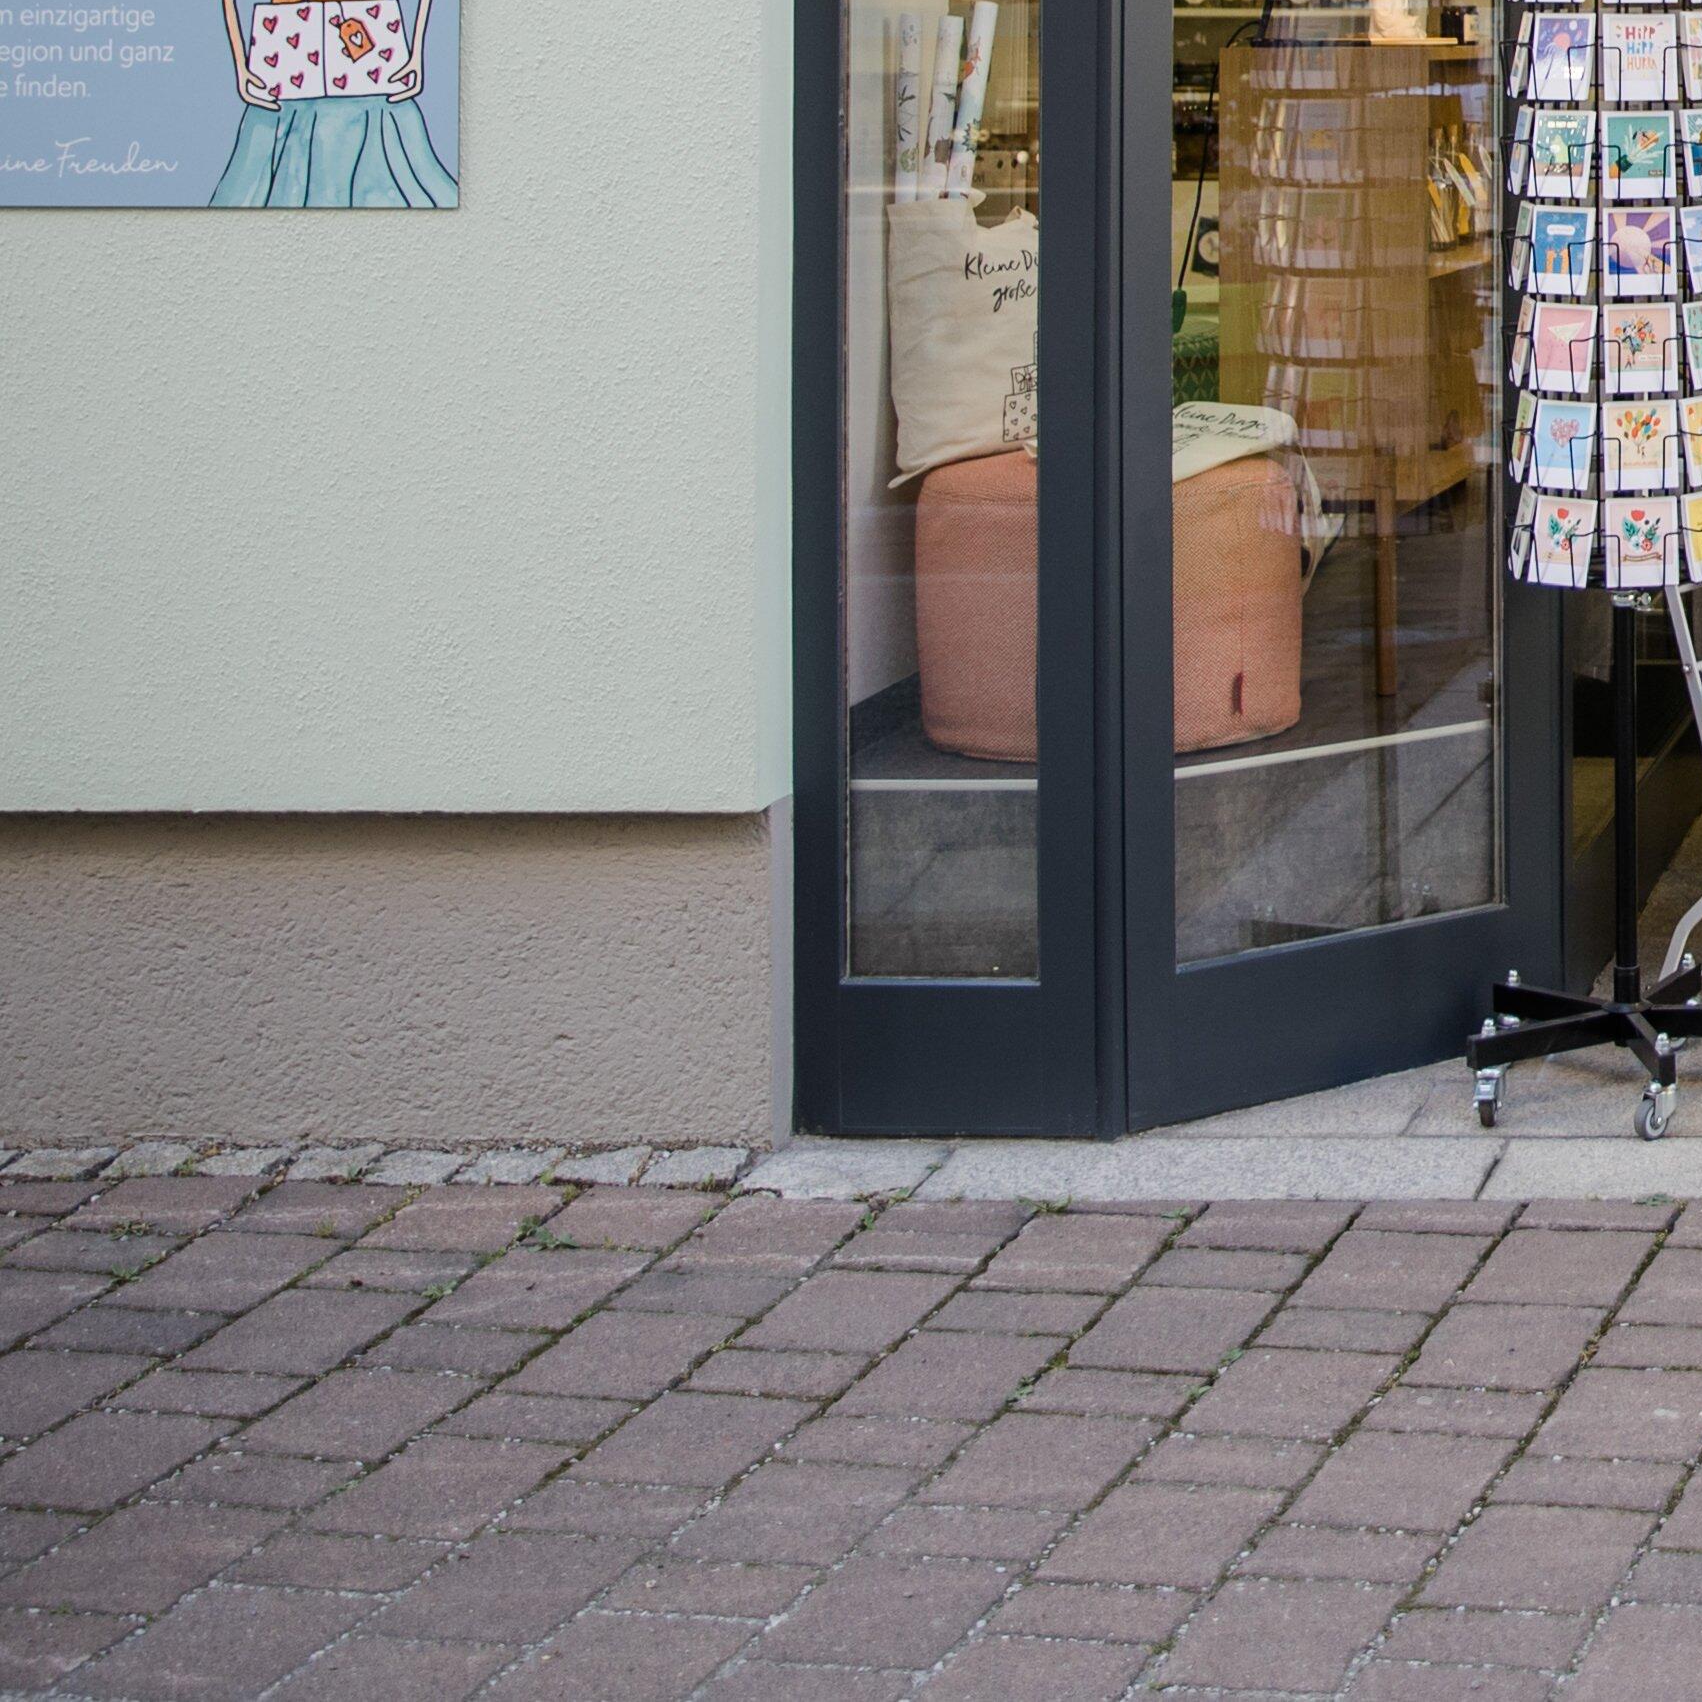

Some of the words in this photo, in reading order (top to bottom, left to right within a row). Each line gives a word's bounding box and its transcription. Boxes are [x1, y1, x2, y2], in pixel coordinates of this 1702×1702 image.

[19, 3, 156, 33] einzigartige
[69, 39, 113, 62] und
[119, 44, 175, 69] ganz
[15, 73, 91, 98] finden.
[54, 136, 179, 179] Freuden
